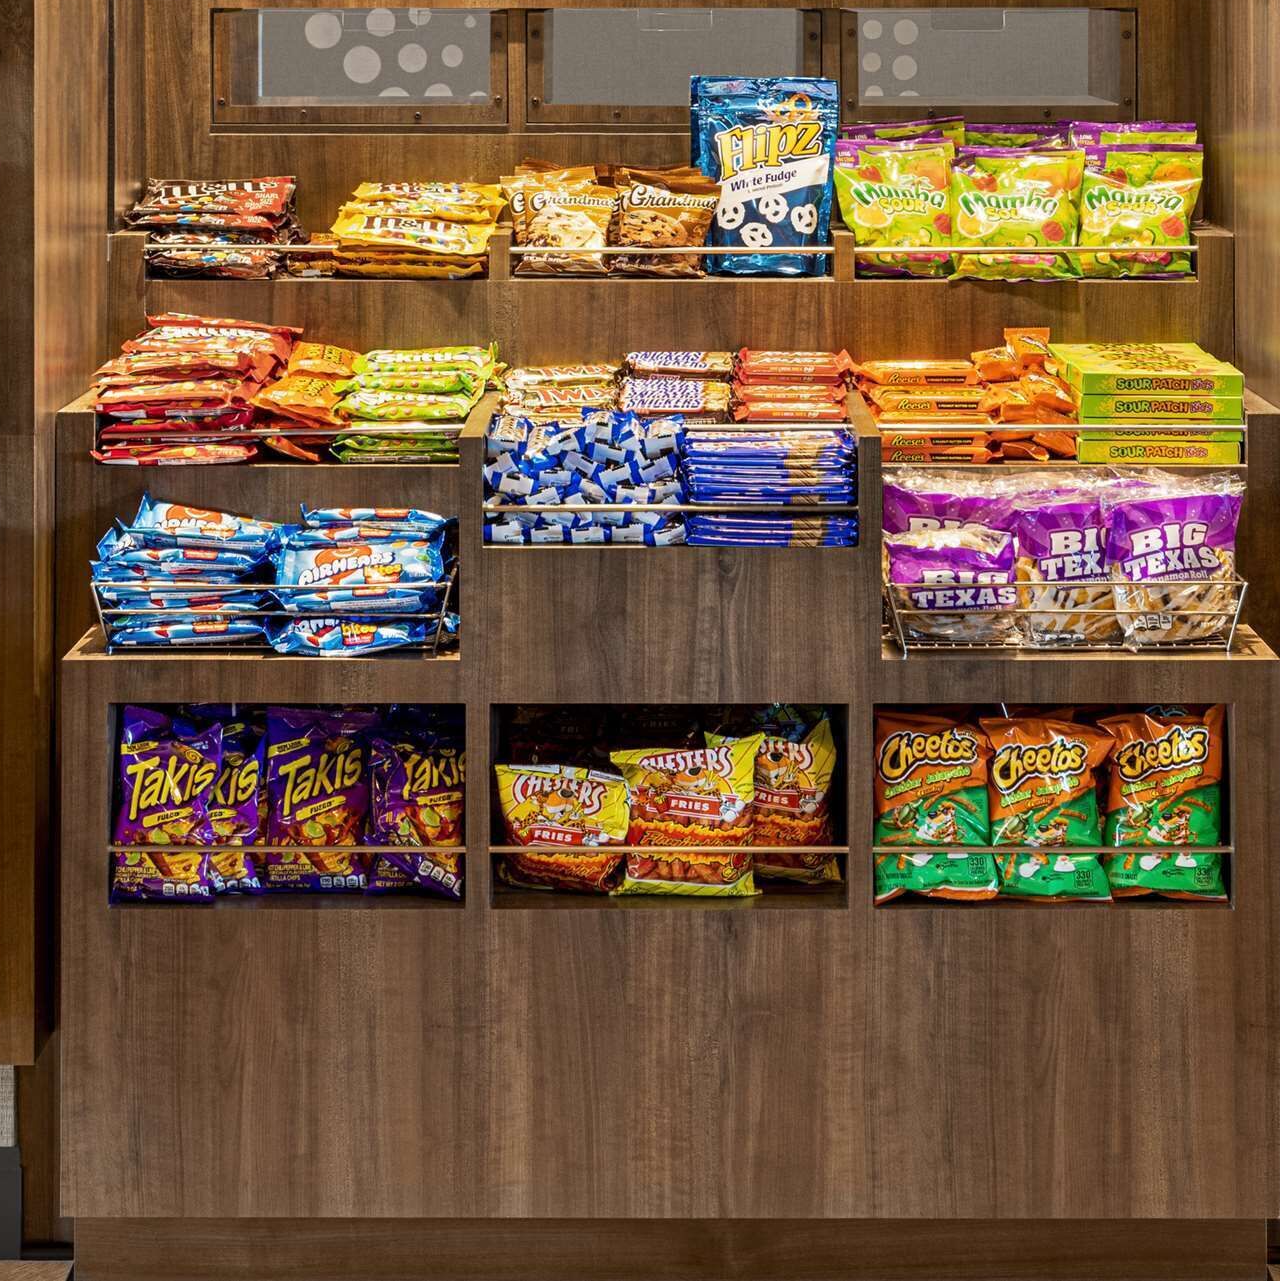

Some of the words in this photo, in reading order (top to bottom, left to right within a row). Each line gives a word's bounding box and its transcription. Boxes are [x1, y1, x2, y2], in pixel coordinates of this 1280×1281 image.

[716, 122, 824, 181] Flipz
[730, 175, 764, 193] Whte
[765, 167, 798, 184] Fudge
[529, 193, 616, 211] Grandma's
[630, 184, 719, 211] Grandma's
[853, 183, 946, 209] Mamba
[879, 197, 926, 214] SOUR
[961, 194, 1058, 216] Mamba
[538, 387, 616, 403] TWIX
[1116, 377, 1152, 391] SOUR
[1152, 378, 1190, 391] PATCH
[627, 400, 702, 408] SNICKERS
[1115, 401, 1151, 413] SOUR
[1151, 401, 1188, 414] PATCH
[1110, 446, 1145, 458] SOUR
[1146, 446, 1183, 458] PATCH
[1050, 528, 1106, 555] BI
[1130, 523, 1209, 556] BIG
[298, 552, 396, 585] AIRHEADS
[1041, 552, 1111, 580] TEX
[1123, 546, 1220, 582] TEXAS
[1190, 570, 1208, 579] Roll
[912, 587, 1017, 609] TEXAS
[881, 730, 975, 780] Cheetos
[993, 738, 1085, 789] Cheetos
[1119, 730, 1205, 777] Cheetos
[670, 799, 710, 812] FRIES
[534, 830, 573, 842] FRIES
[969, 857, 985, 866] 330
[1075, 870, 1091, 880] 330
